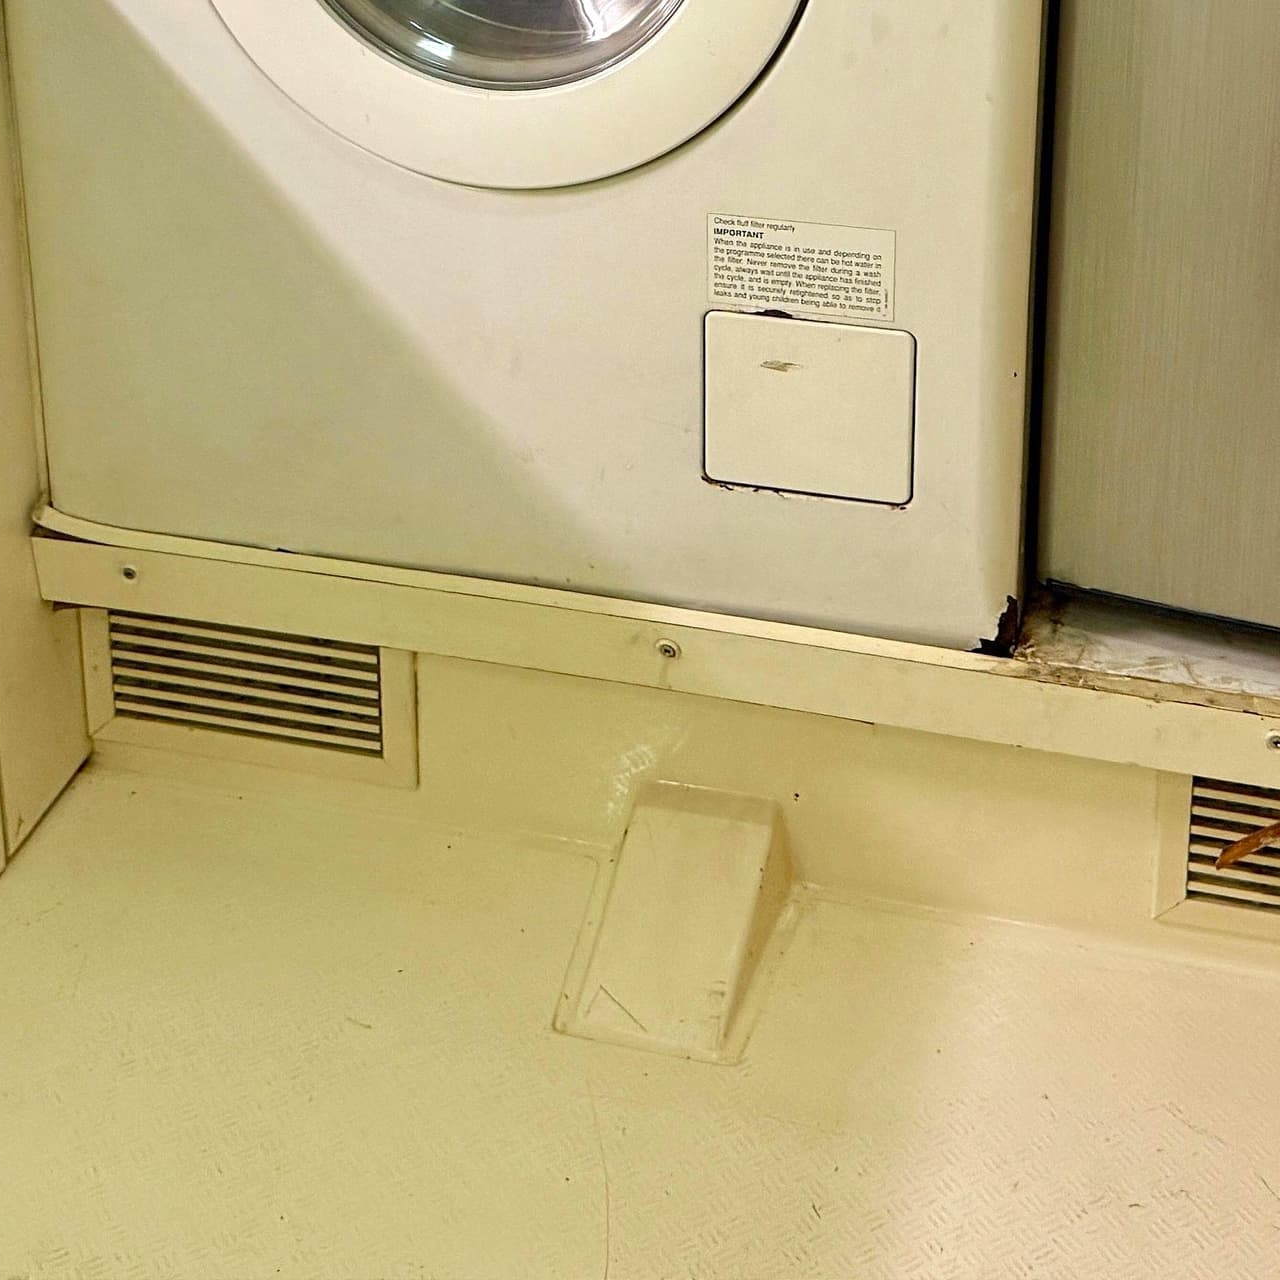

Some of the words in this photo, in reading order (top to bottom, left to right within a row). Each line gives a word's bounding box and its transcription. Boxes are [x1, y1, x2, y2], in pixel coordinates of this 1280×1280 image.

[713, 228, 764, 239] IMPORTANT
[714, 216, 735, 226] Check
[751, 220, 765, 228] filter
[766, 223, 795, 232] regularly
[714, 237, 734, 246] When
[736, 240, 747, 248] the
[750, 242, 783, 252] appliance
[818, 248, 831, 256] and
[833, 250, 870, 261] depending
[714, 246, 725, 254] the
[726, 248, 765, 258] programme
[766, 252, 796, 261] selected
[797, 255, 815, 263] there
[854, 261, 874, 269] water
[874, 262, 882, 270] in
[714, 255, 725, 263] the
[746, 258, 767, 267] Never
[770, 261, 796, 270] remove
[798, 263, 810, 272] the
[812, 264, 828, 273] filter
[830, 267, 853, 277] during
[735, 266, 758, 276] always
[791, 271, 803, 279] the
[805, 273, 838, 283] appliance
[839, 276, 853, 284] has
[854, 278, 881, 287] finished
[714, 272, 725, 280] the
[748, 276, 762, 284] and
[795, 280, 816, 289] When
[818, 283, 850, 294] replacing
[714, 282, 738, 290] ensure
[758, 286, 786, 295] securely
[789, 289, 828, 299] retightened
[855, 295, 863, 303] to
[865, 297, 882, 305] stop
[714, 289, 732, 297] leaks
[749, 294, 770, 303] young
[772, 296, 799, 304] children
[800, 298, 820, 308] being
[848, 304, 875, 312] remove
